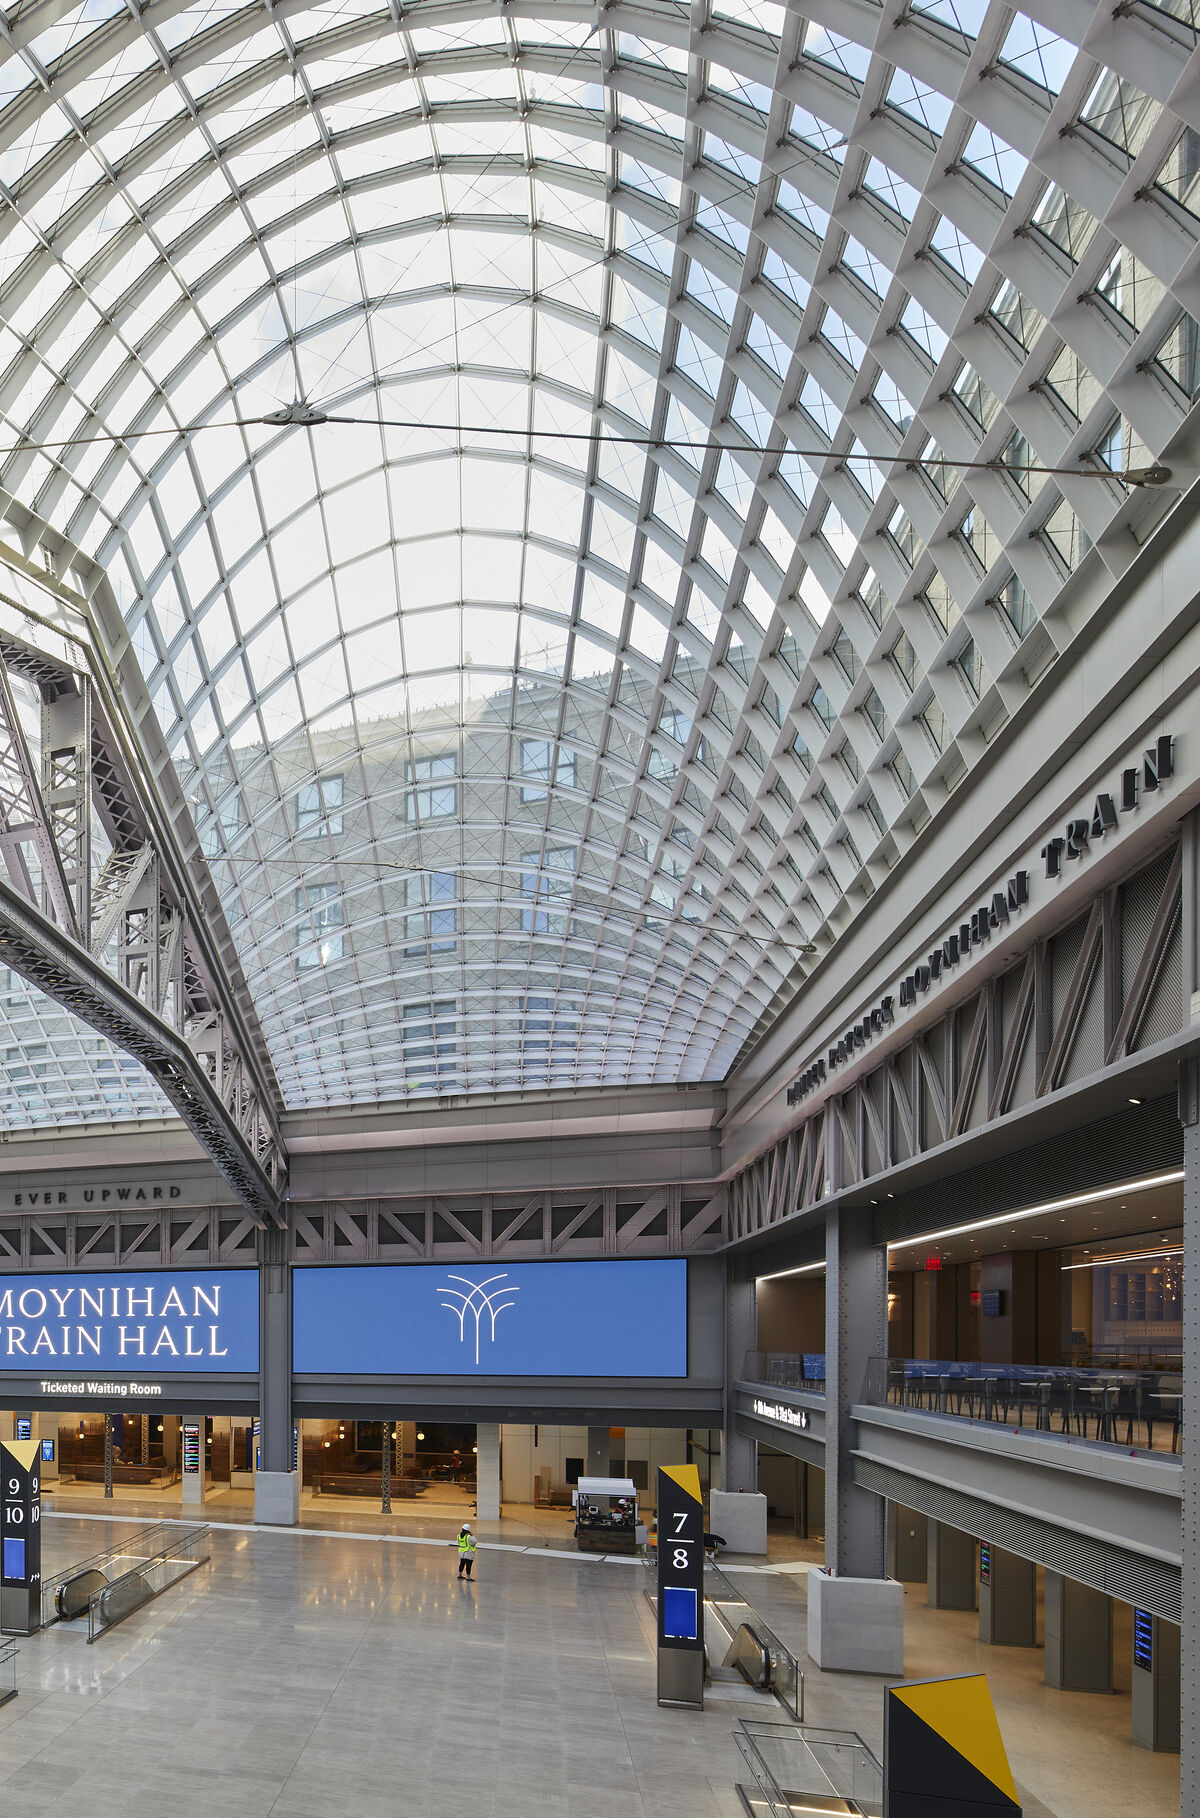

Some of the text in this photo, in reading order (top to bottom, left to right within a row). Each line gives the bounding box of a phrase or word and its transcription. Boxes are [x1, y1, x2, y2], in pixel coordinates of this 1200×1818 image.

[899, 870, 1029, 1008] MOYNIHAN
[1041, 735, 1174, 878] TRAIN
[14, 1186, 181, 1206] EVER UPWARD
[118, 1325, 228, 1356] HALL
[40, 1382, 161, 1396] Ticketed Waiting Room
[9, 1478, 20, 1495] 9
[32, 1478, 38, 1494] 9
[6, 1507, 24, 1524] 10
[31, 1505, 39, 1524] 10
[673, 1512, 688, 1533] 7
[672, 1549, 688, 1569] 8
